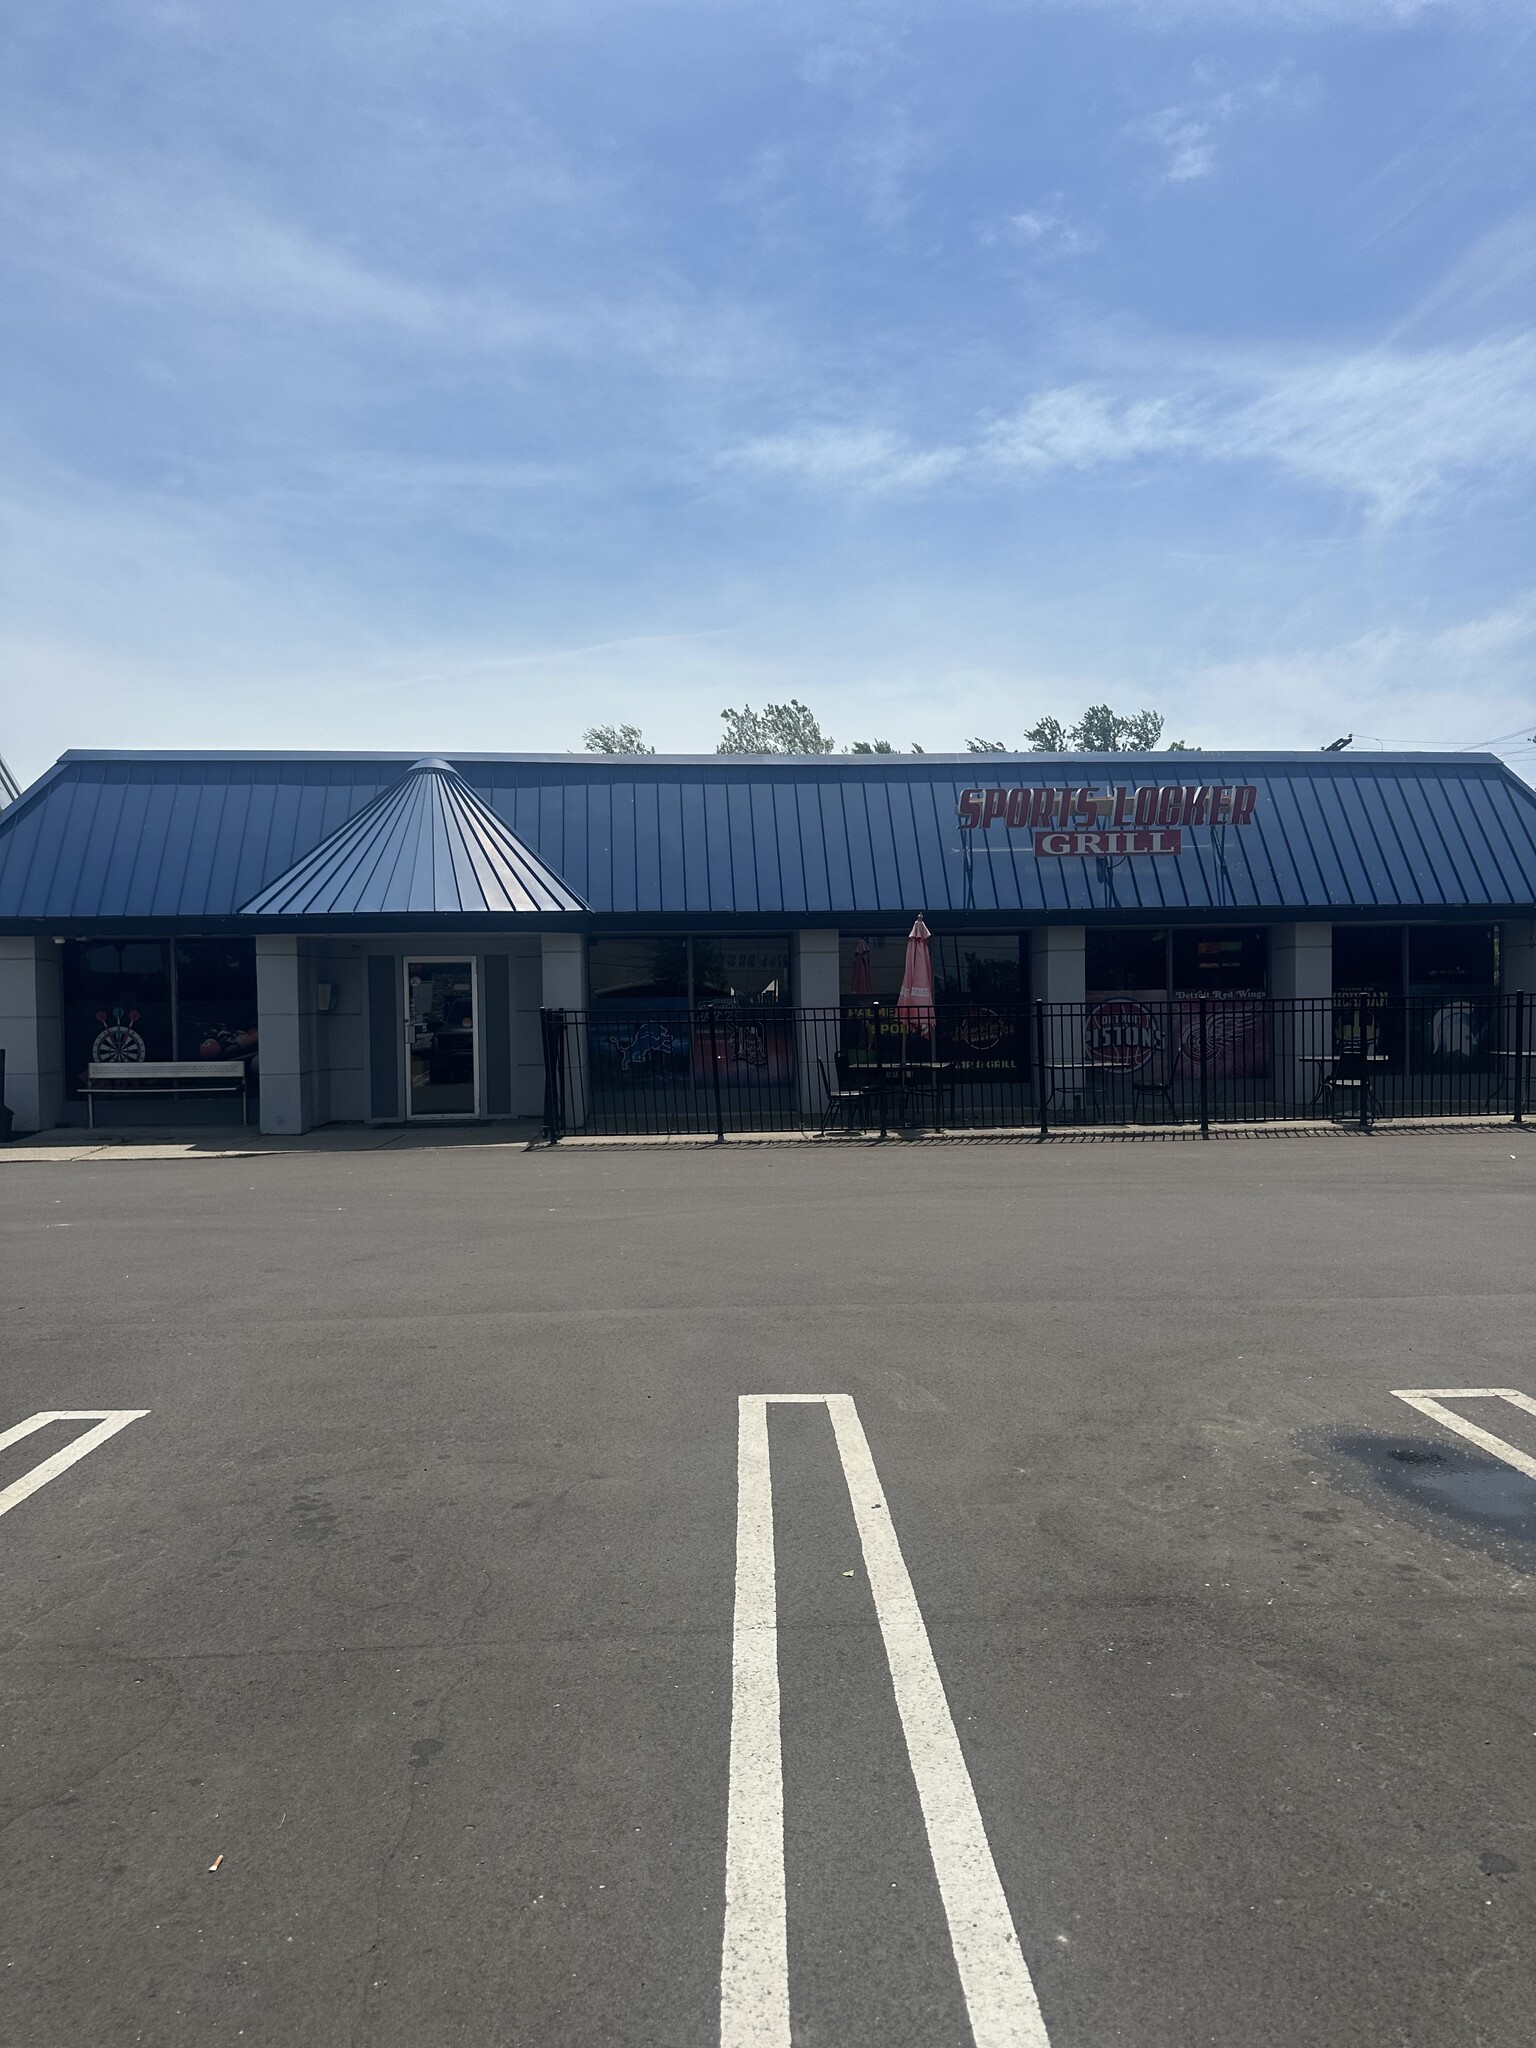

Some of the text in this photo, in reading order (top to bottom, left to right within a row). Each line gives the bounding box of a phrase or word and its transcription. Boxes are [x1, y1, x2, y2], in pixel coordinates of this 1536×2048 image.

[956, 785, 1257, 829] SPORTS LOCKER
[1041, 832, 1175, 855] GRILL
[1175, 988, 1267, 999] Detroit Red Wings
[848, 1007, 895, 1017] PALME
[986, 1060, 1017, 1069] GRILL
